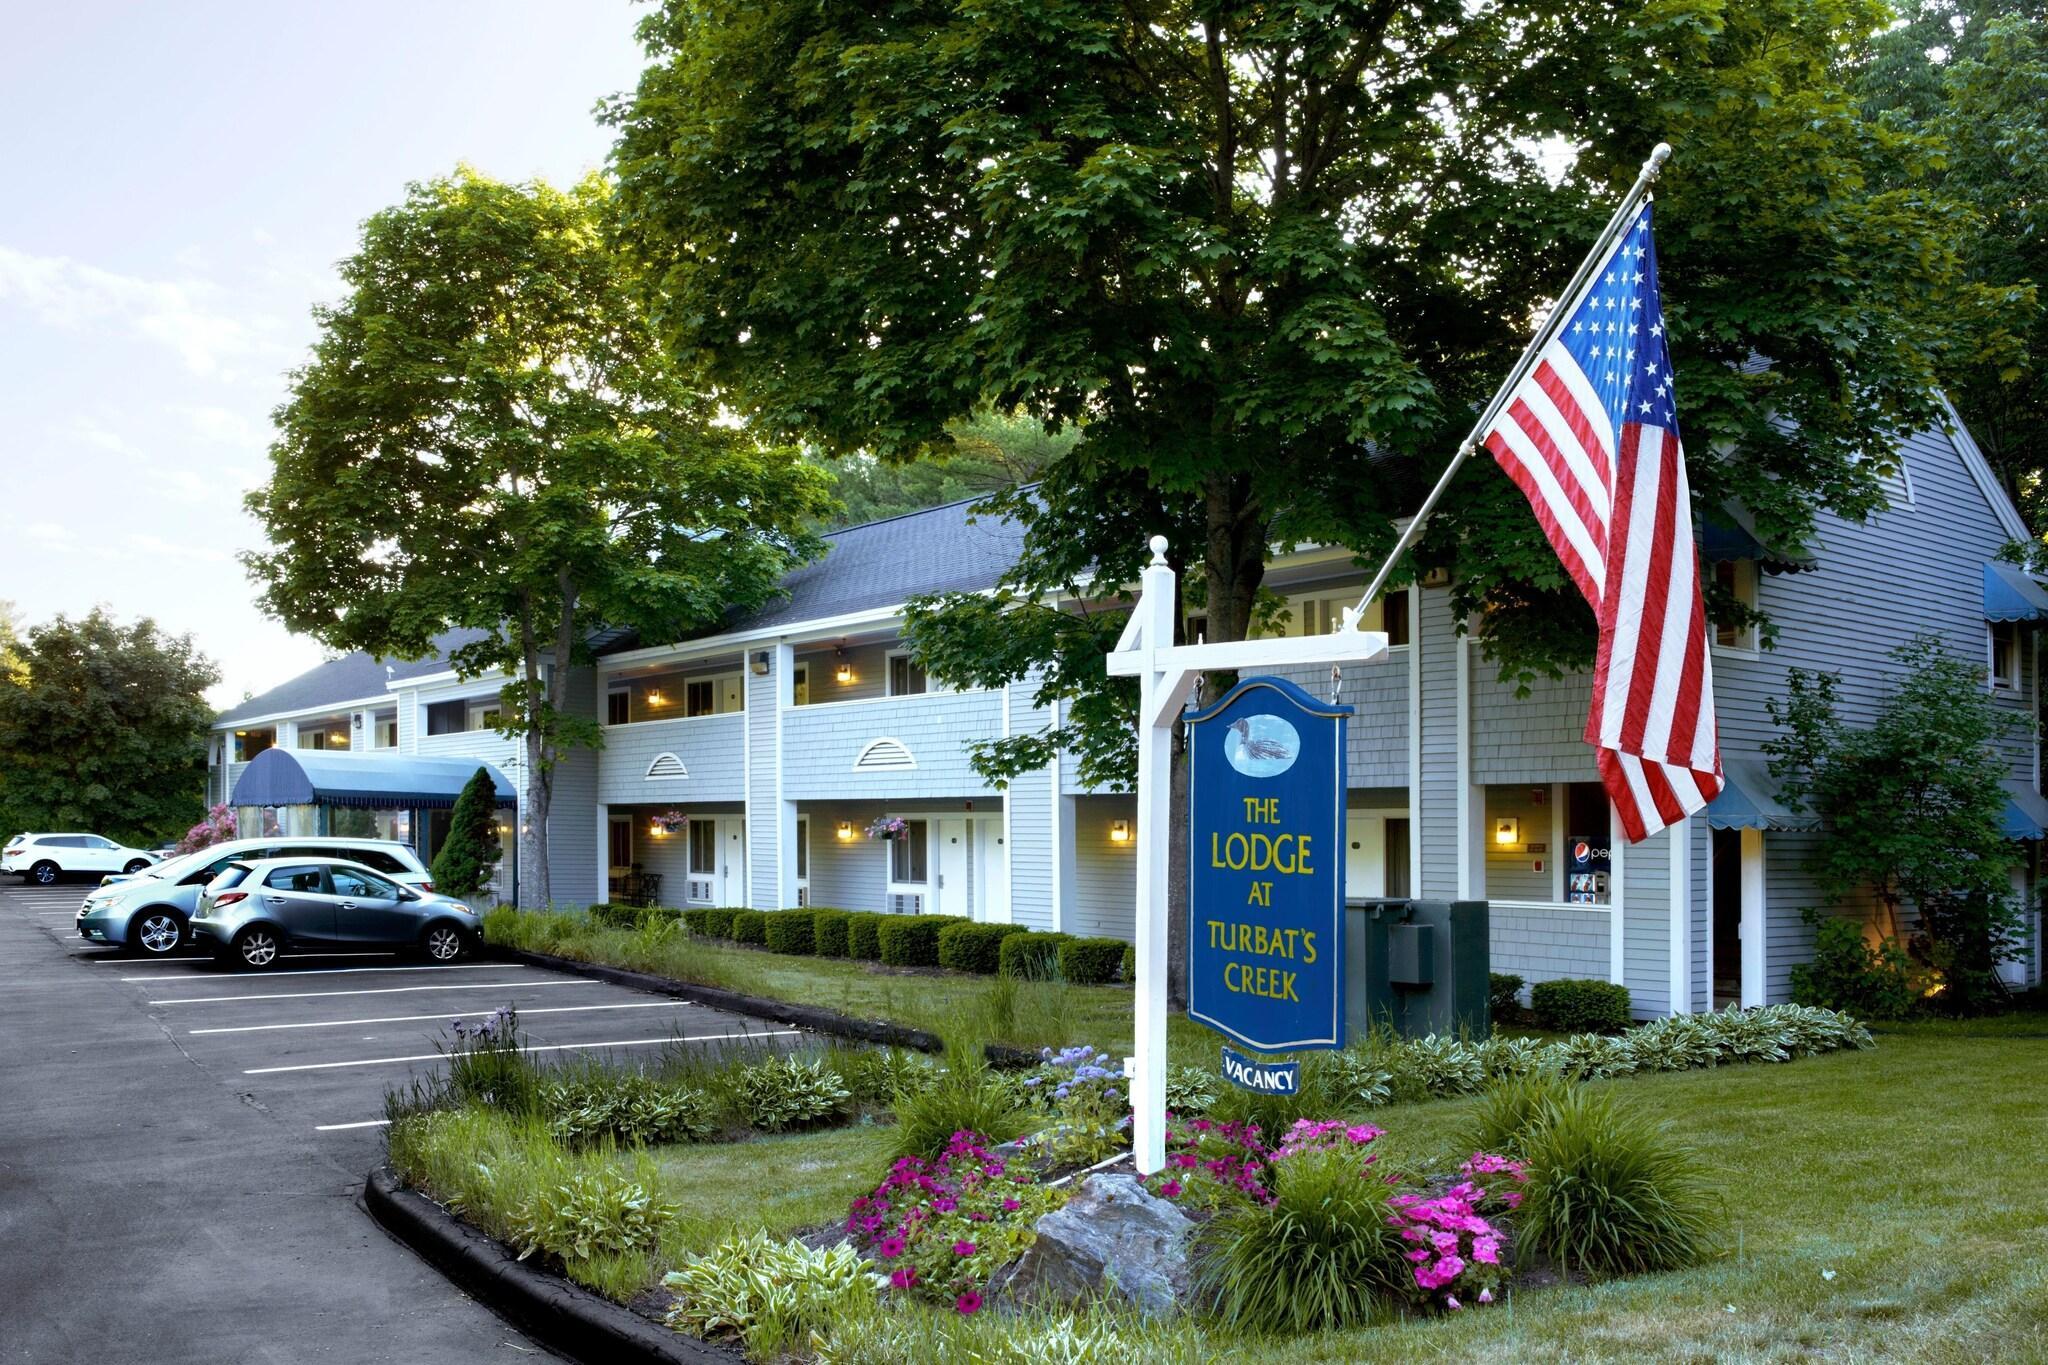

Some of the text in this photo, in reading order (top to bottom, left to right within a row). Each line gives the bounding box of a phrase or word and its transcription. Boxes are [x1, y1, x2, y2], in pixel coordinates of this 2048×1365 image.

[1243, 797, 1281, 824] THE
[1211, 832, 1315, 874] LODGE
[1248, 881, 1273, 906] AT
[1207, 920, 1317, 964] TURBAT'S
[1224, 962, 1299, 1002] CREEK
[1225, 1055, 1294, 1090] VACANCY
